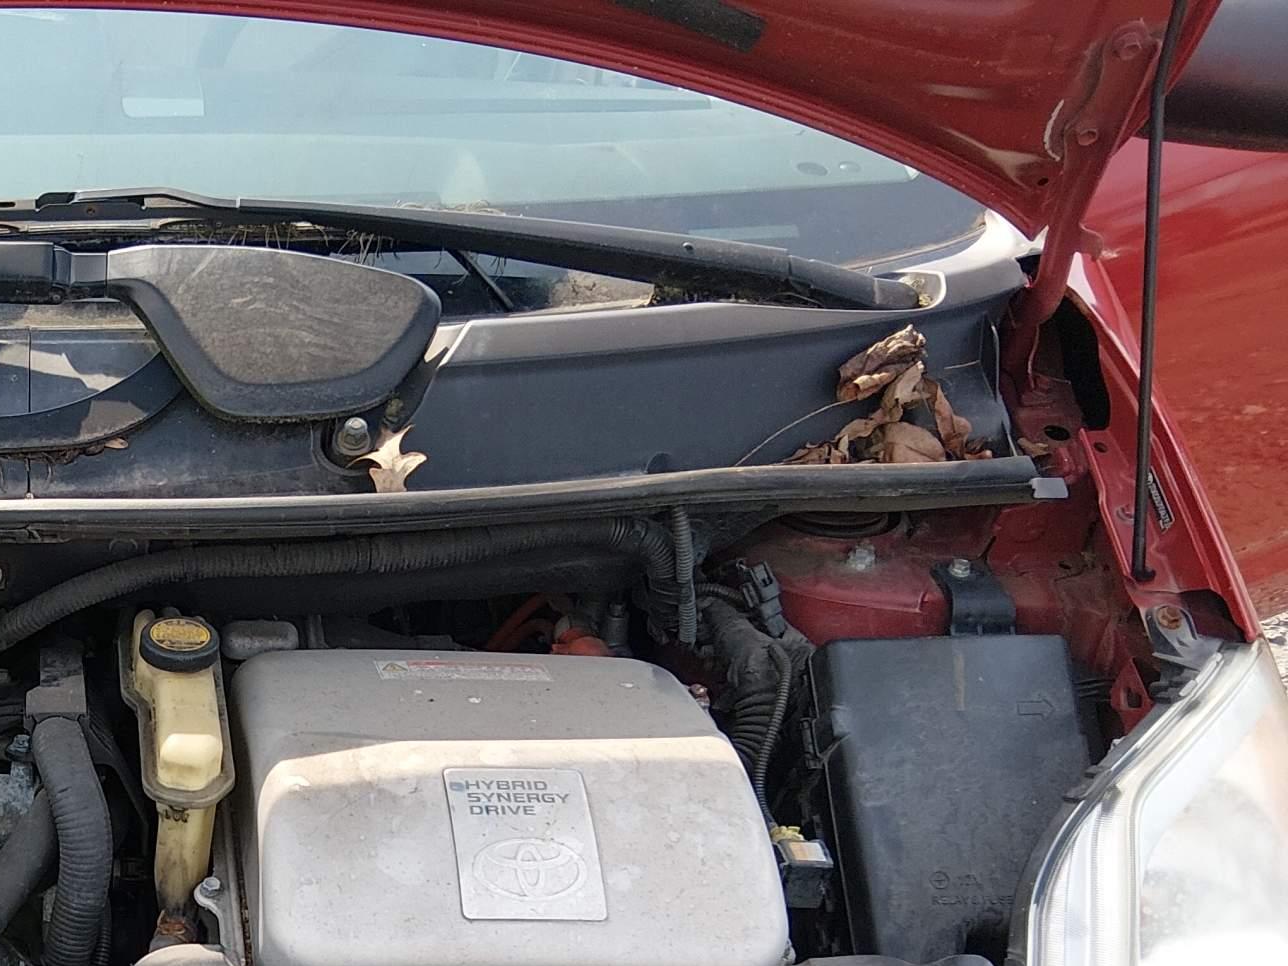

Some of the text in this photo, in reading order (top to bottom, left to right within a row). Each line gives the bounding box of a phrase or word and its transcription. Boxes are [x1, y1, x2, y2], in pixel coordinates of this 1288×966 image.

[464, 780, 548, 791] HYBRID
[466, 792, 570, 804] SYNERGY
[469, 805, 537, 816] DRIVE
